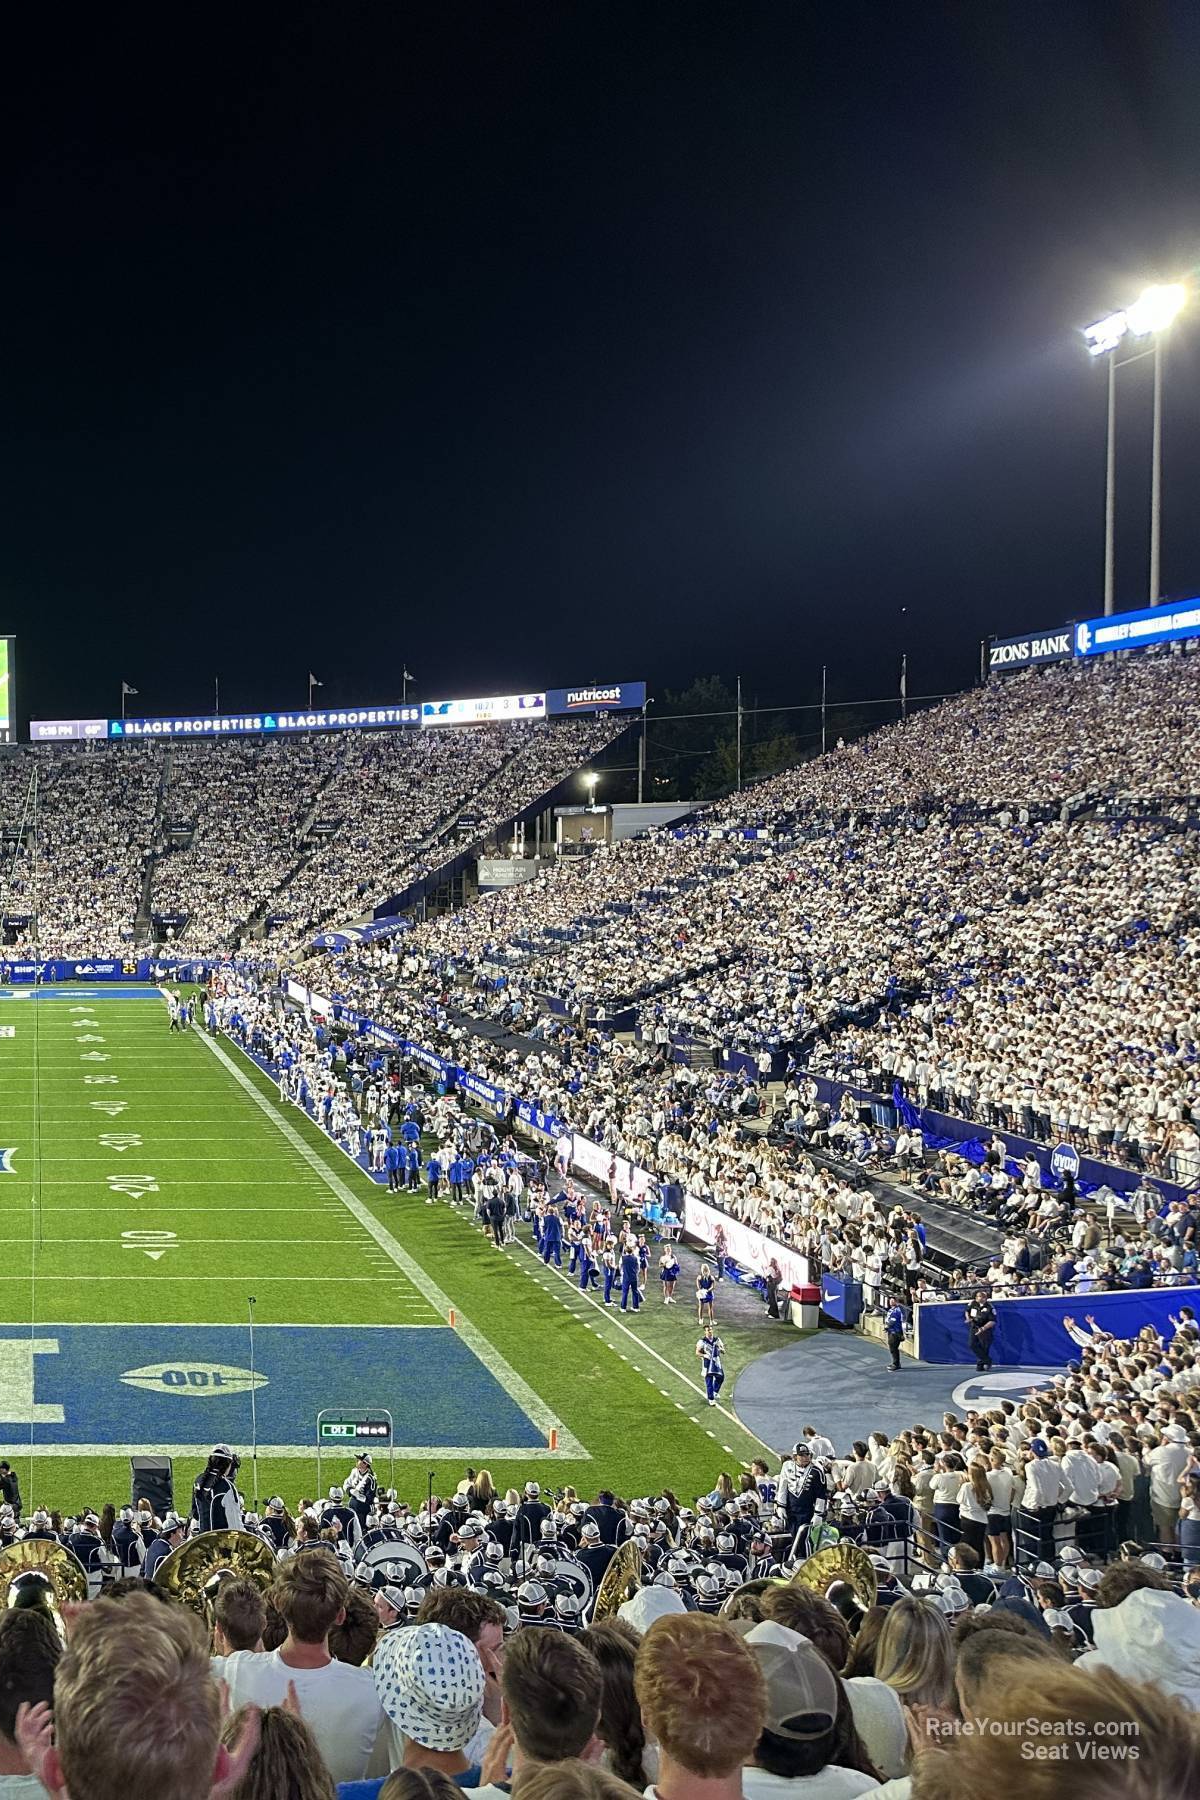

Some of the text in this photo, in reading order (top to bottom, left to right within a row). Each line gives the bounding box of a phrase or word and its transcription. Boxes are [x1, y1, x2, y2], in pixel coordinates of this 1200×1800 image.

[990, 634, 1070, 665] ZIONS BANK
[567, 687, 621, 703] nutricost
[124, 718, 261, 734] BLACK PROPERTIES
[278, 709, 419, 728] BLACK PROPERTIES
[123, 963, 136, 974] 25
[98, 1133, 144, 1146] 30
[376, 1133, 385, 1142] 70
[1053, 1152, 1077, 1172] ROAR
[106, 1174, 160, 1192] 20
[120, 1230, 180, 1249] 10
[758, 1483, 777, 1503] 96
